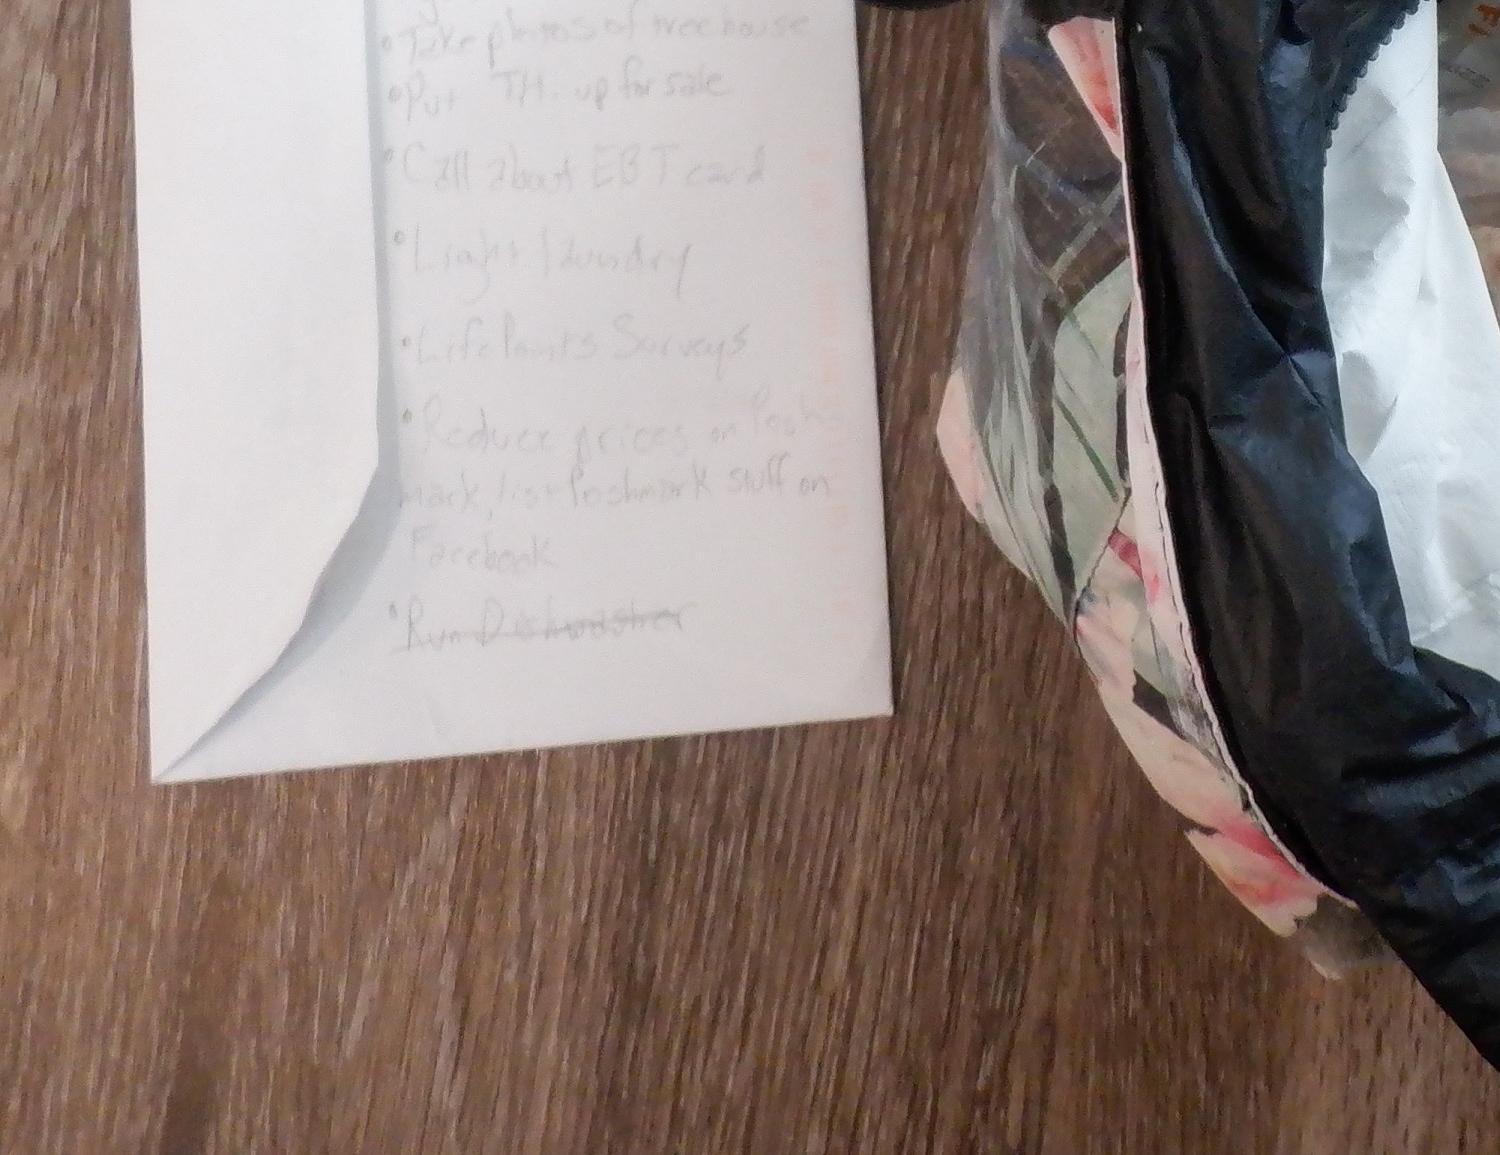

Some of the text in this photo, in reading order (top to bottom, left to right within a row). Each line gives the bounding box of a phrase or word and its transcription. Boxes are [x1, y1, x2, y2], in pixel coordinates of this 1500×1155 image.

[405, 70, 460, 122] Put
[574, 80, 609, 113] up
[622, 54, 652, 101] for
[663, 65, 728, 100] sale
[402, 141, 768, 193] Call about EBT card
[421, 394, 551, 452] Reduce
[576, 423, 690, 474] prices
[727, 450, 792, 495] stuff
[799, 473, 833, 498] on
